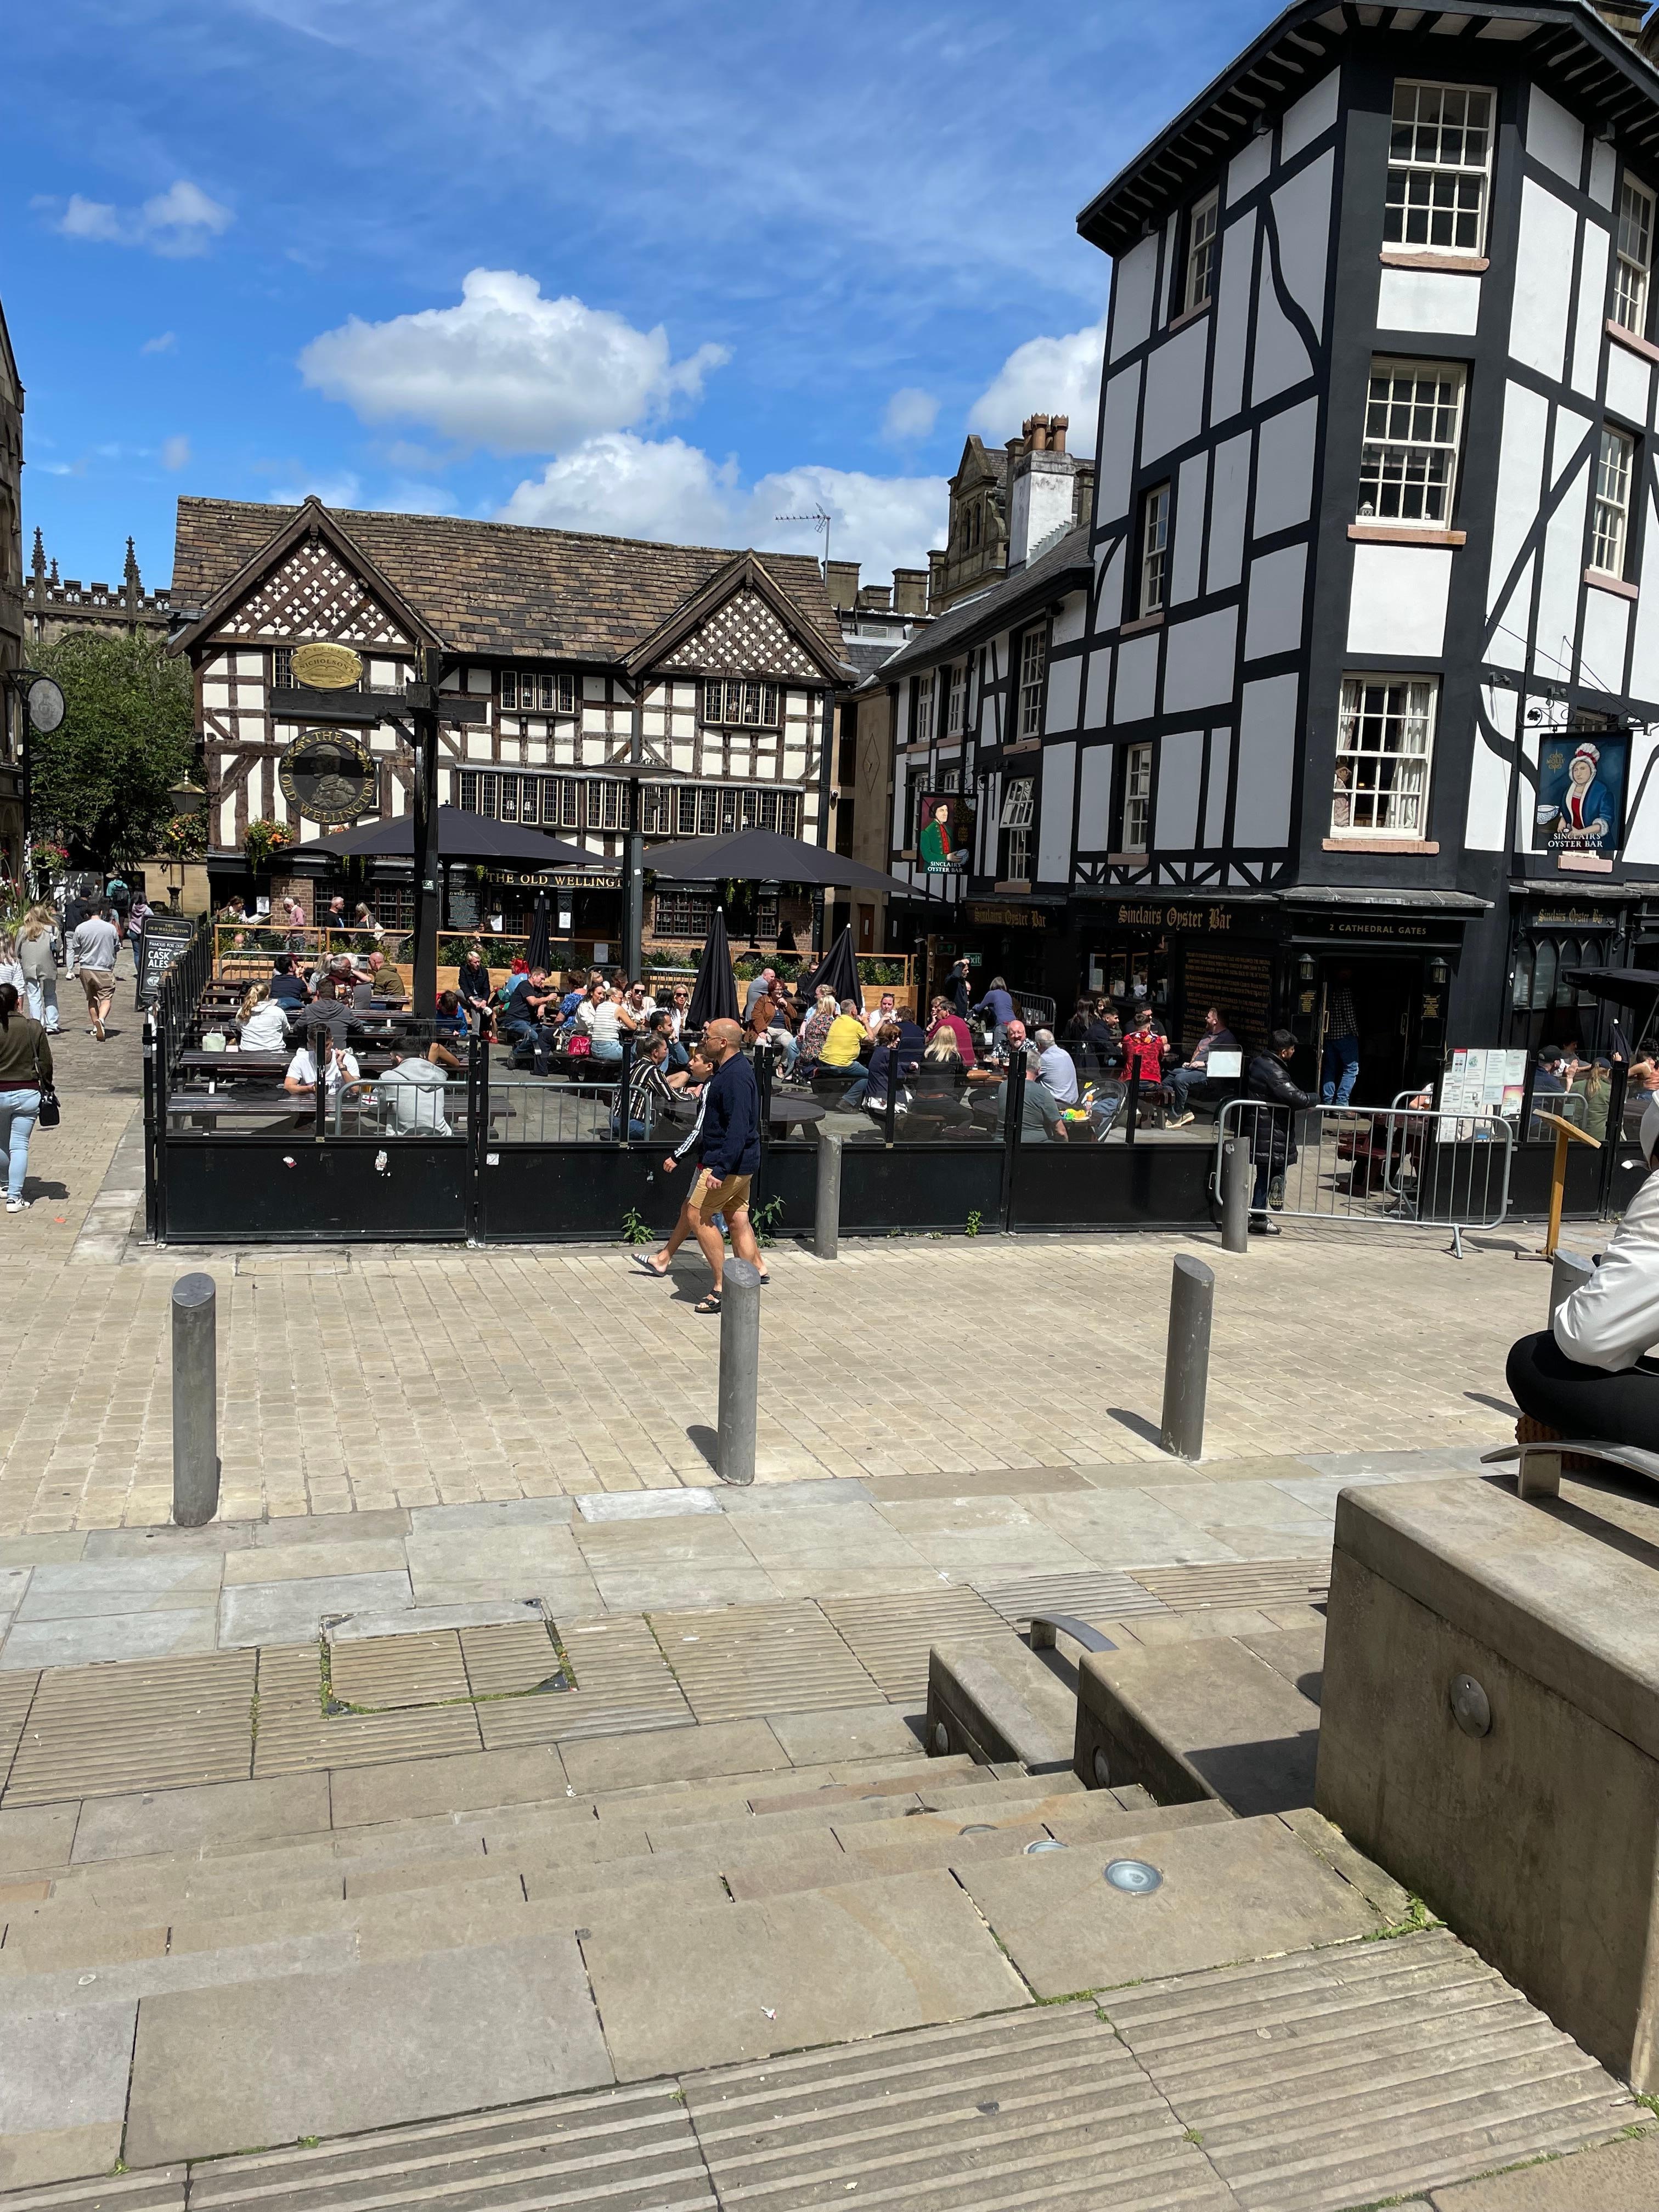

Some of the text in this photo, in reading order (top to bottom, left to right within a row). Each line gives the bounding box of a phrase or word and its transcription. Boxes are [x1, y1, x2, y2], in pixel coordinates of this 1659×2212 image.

[312, 731, 343, 743] THE
[280, 774, 375, 822] OLD WELLINGTON
[486, 873, 623, 887] THE OLD WELLINGT
[1005, 909, 1028, 928] Oyster
[1031, 910, 1046, 928] Bar
[1166, 906, 1203, 931] Oyster
[1209, 907, 1232, 932] Bar
[1339, 924, 1395, 933] CATHEDRAL
[1398, 927, 1427, 935] GATES
[148, 950, 170, 961] CASK
[148, 959, 169, 968] ALES
